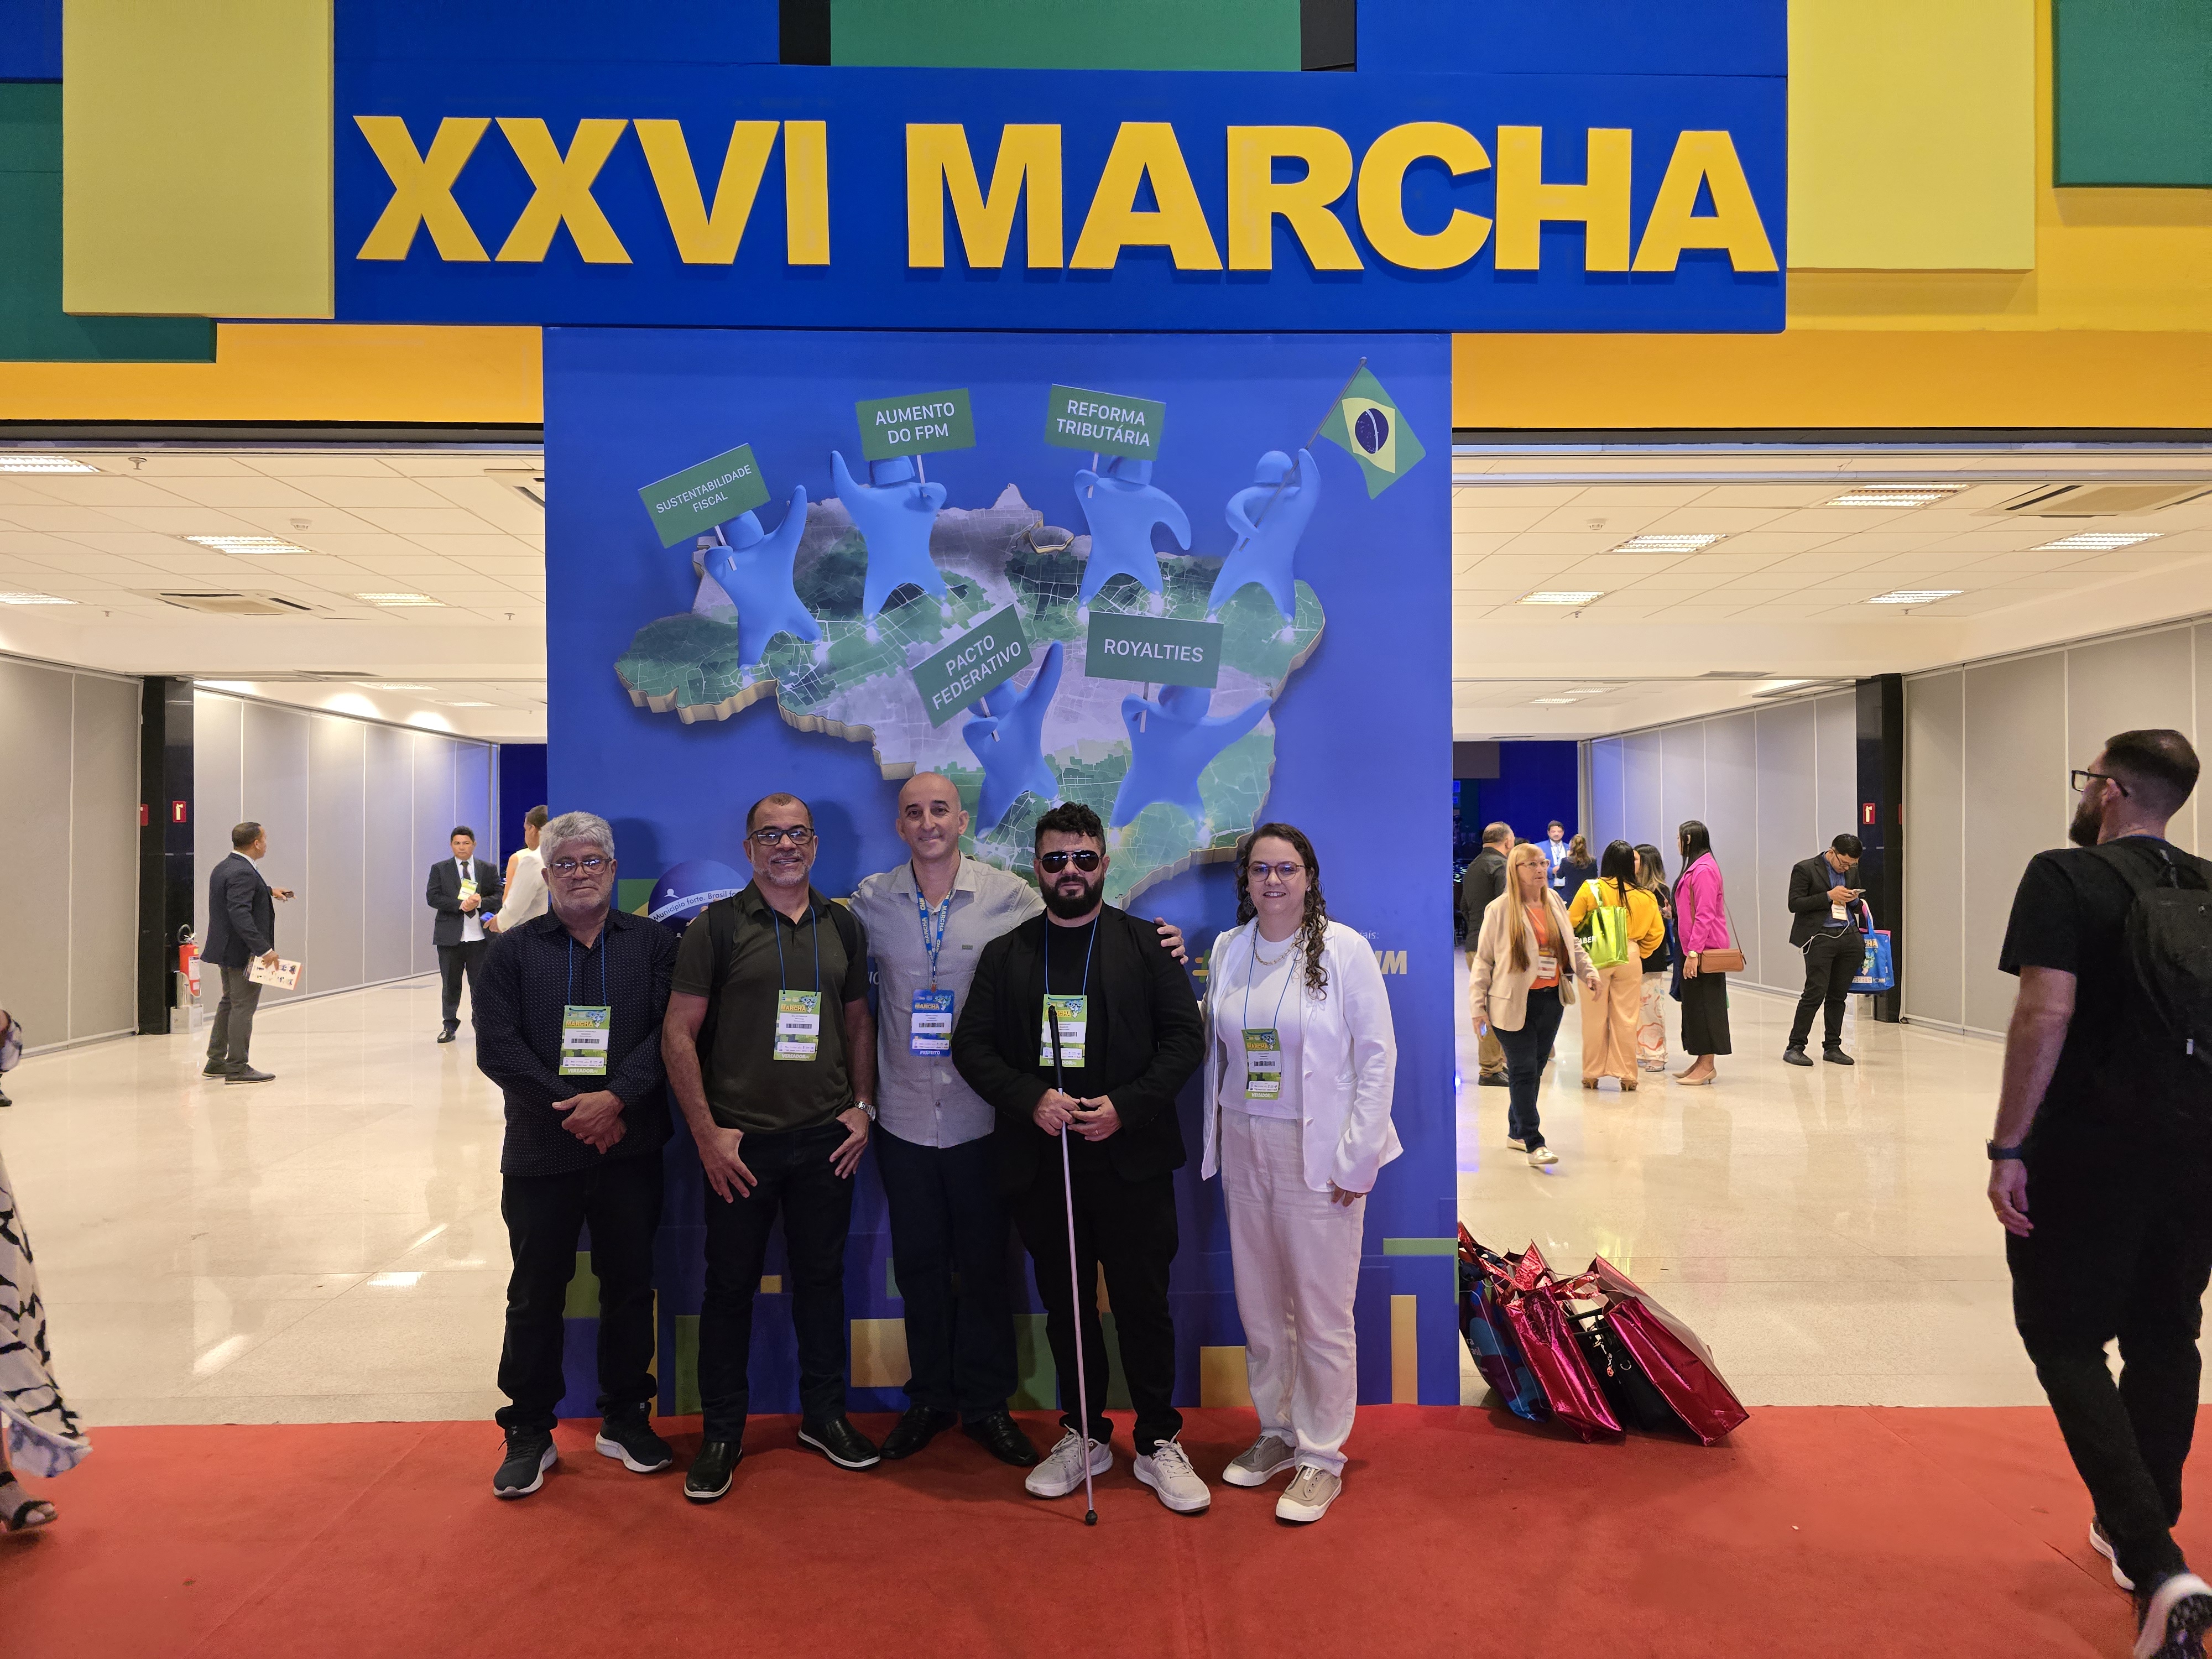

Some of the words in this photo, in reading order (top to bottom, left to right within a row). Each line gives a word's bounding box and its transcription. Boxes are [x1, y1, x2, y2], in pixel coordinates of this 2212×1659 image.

[354, 116, 830, 265] XXVI
[905, 121, 1778, 272] MARCHA
[875, 402, 955, 426] AUMENTO
[1067, 399, 1146, 426] REFORMA
[888, 428, 911, 444] DO
[915, 423, 949, 440] FPM
[1056, 418, 1150, 447] TRIBUTÁRIA
[656, 465, 752, 513] SUSTENTABILIDADE
[692, 492, 728, 513] FISCAL
[946, 635, 995, 676] PACTO
[1104, 639, 1204, 662] ROYALTIES
[932, 641, 1021, 710] FEDERATIVO
[653, 902, 685, 921] Município
[687, 896, 706, 905] forte.
[707, 891, 727, 899] Brasil
[938, 905, 947, 932] MARCHA
